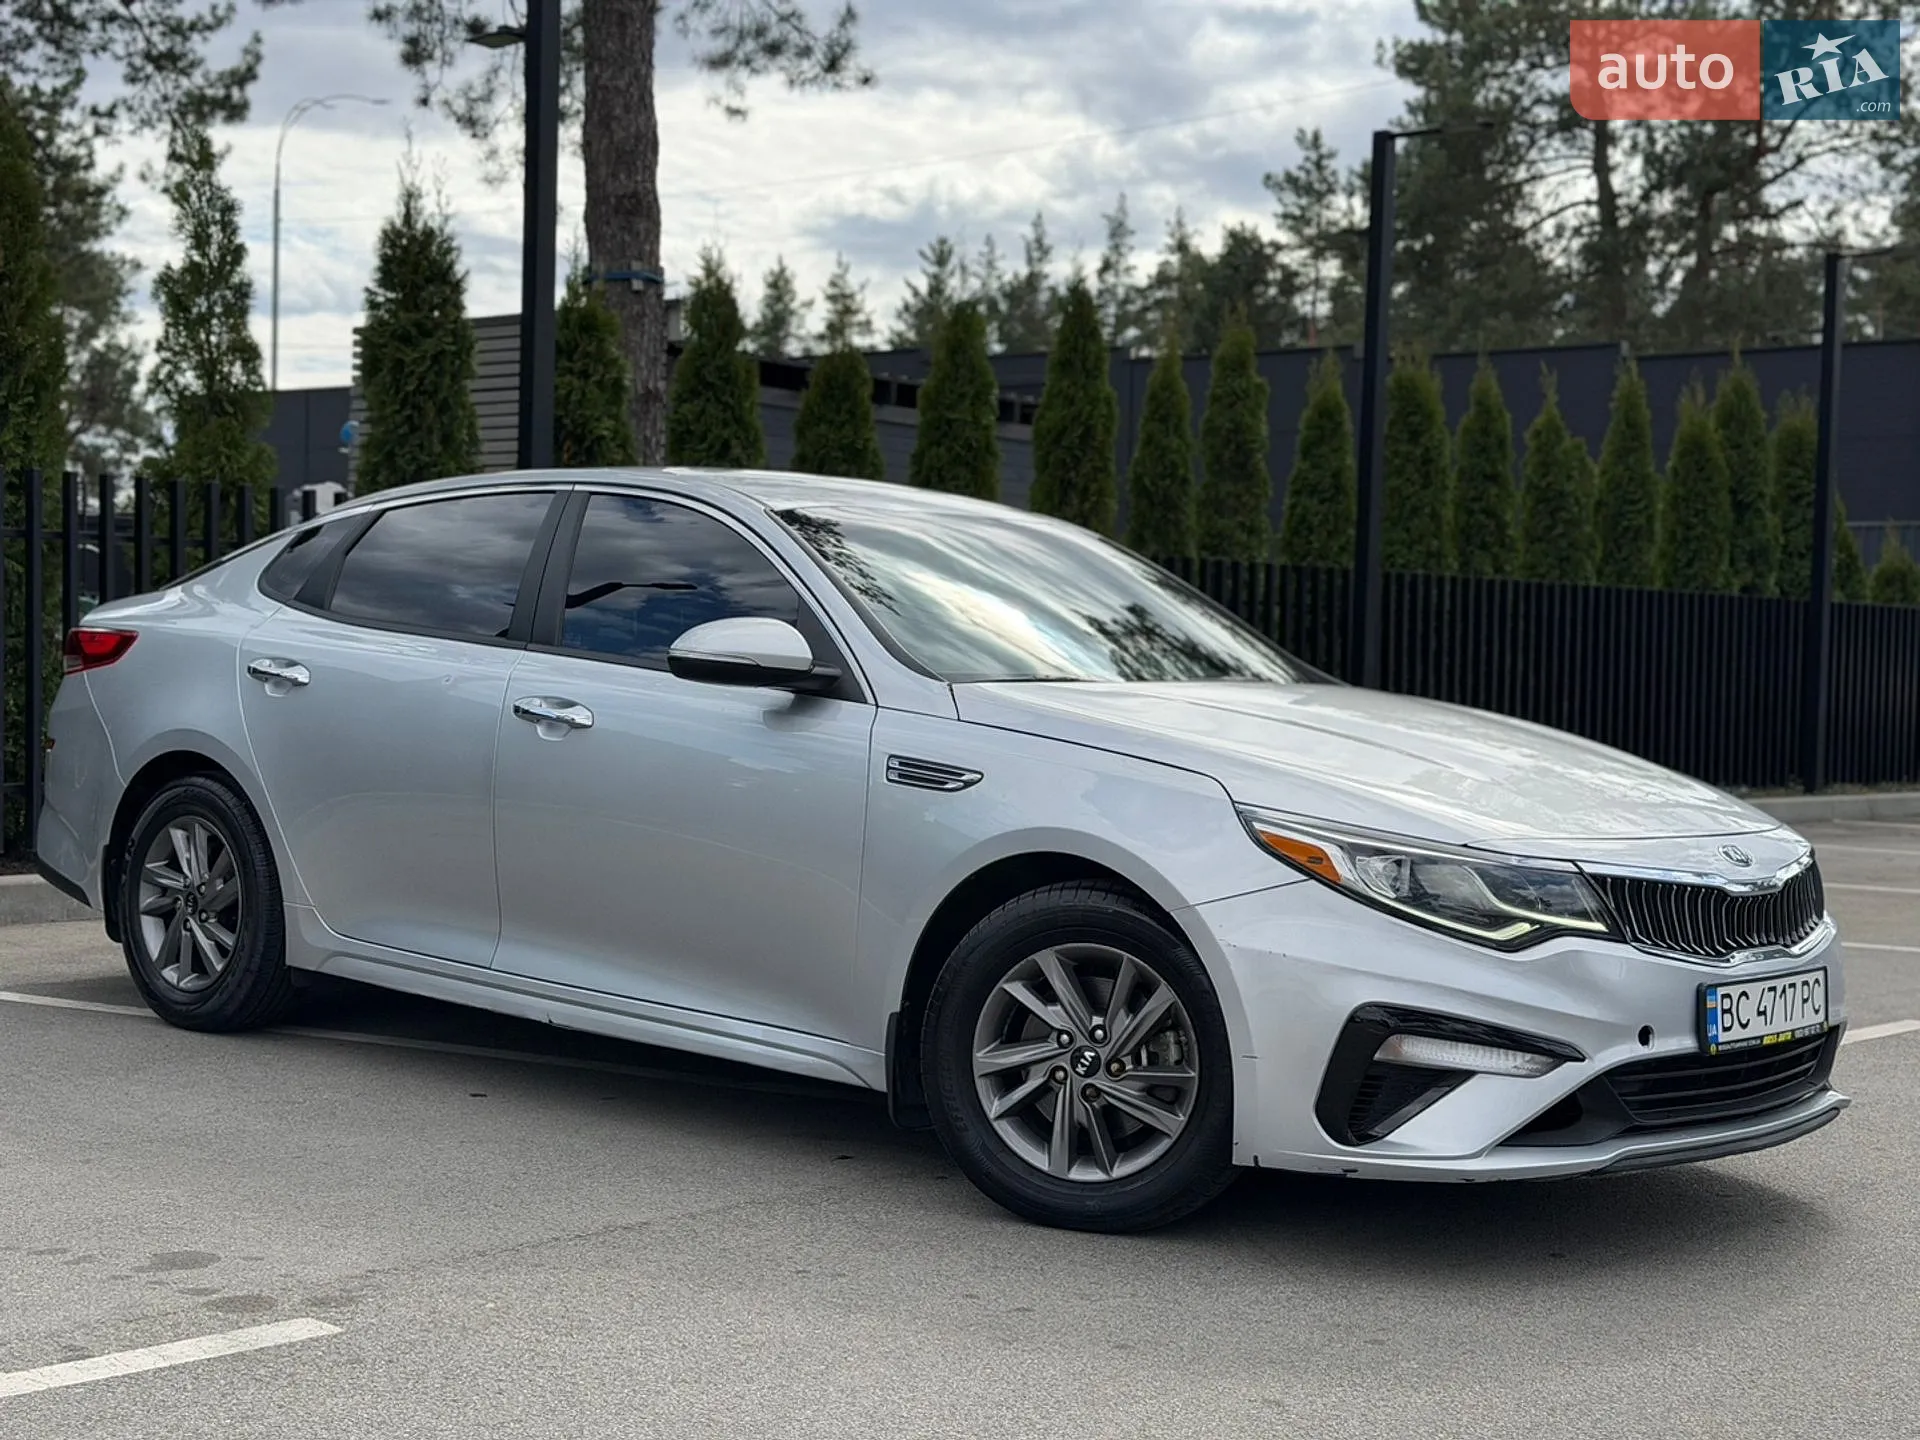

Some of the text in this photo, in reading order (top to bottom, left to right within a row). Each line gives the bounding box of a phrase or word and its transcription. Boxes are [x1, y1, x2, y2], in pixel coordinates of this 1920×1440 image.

[1720, 977, 1821, 1033] BC 4717 PC
[1706, 1024, 1717, 1036] UA
[1075, 1051, 1096, 1075] KIA
